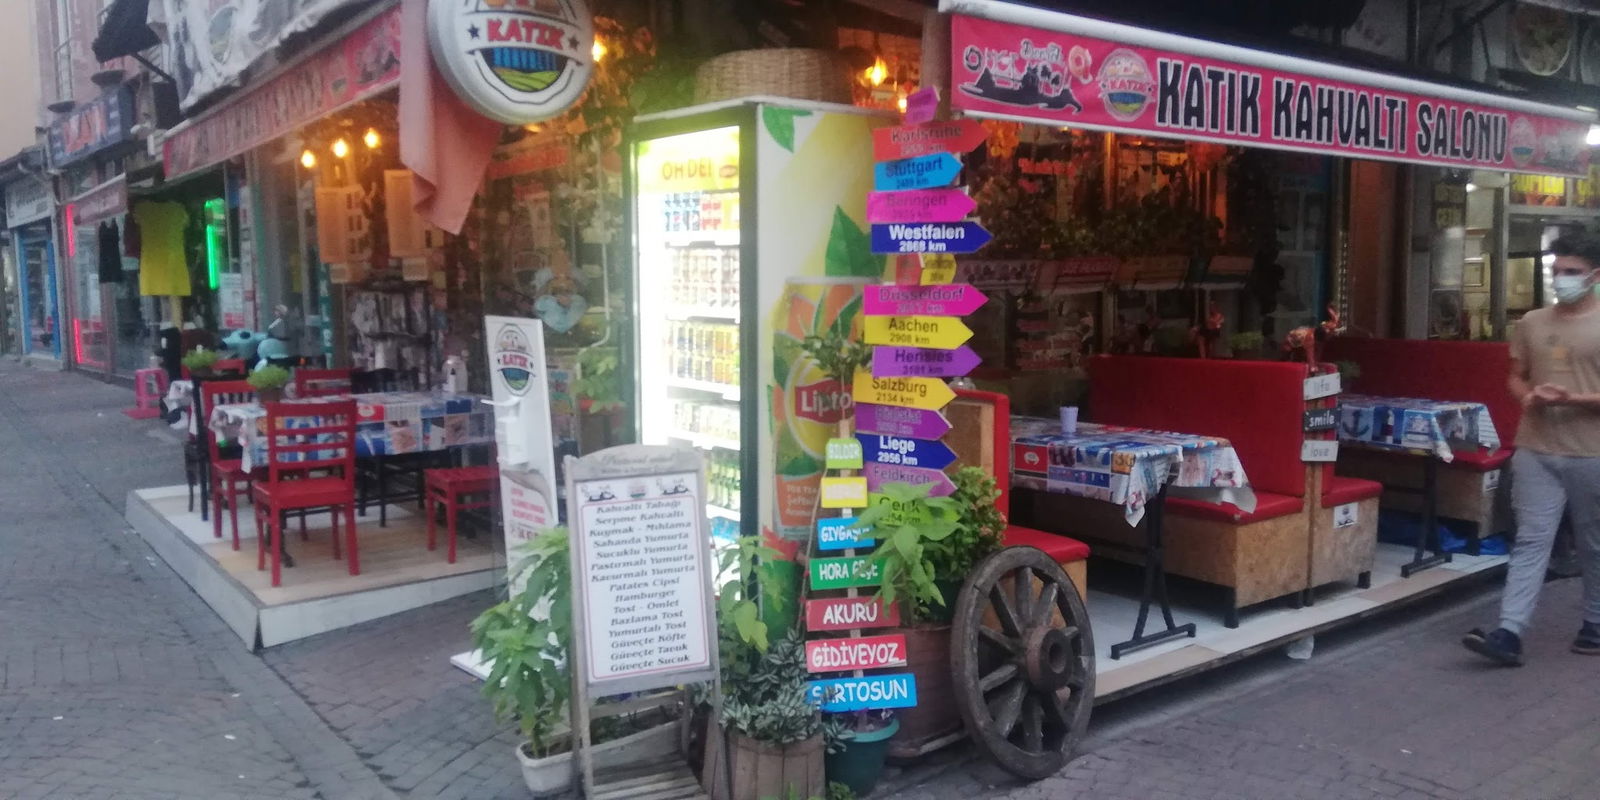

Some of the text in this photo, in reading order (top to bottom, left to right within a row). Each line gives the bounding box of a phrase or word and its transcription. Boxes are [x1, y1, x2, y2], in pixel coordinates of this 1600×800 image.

[487, 18, 566, 50] KATIK
[1156, 58, 1507, 163] KATIK KAHVALTI SALONU
[891, 126, 962, 143] Karlsruhe
[885, 156, 943, 178] Stuttgart
[889, 225, 965, 240] Westfalen
[928, 240, 946, 252] km
[888, 317, 938, 333] Aachen
[915, 335, 930, 345] km
[928, 365, 944, 374] km
[871, 377, 927, 397] Salzburg
[801, 389, 856, 416] Lipto
[900, 395, 915, 405] km
[1309, 410, 1335, 428] smile
[879, 435, 916, 454] Liege
[902, 455, 918, 466] km
[595, 515, 637, 525] Serpme
[589, 526, 634, 538] Kuymak
[593, 532, 689, 548] Sahanda Yumurta
[596, 543, 688, 559] Sucuklu Yumurta
[650, 553, 694, 564] Yumurta
[651, 564, 695, 576] Yumurta
[818, 562, 849, 580] HORA
[609, 581, 649, 592] Patates
[615, 589, 676, 603] Hamburger
[613, 605, 636, 614] Tost
[647, 599, 679, 610] Omlet
[822, 602, 878, 625] AKURU
[610, 610, 684, 626] Bazlama Tost
[609, 621, 687, 638] Yumurtalı Tost
[657, 633, 687, 643] Köfte
[658, 643, 688, 654] Tavuk
[811, 642, 904, 668] GİDİVEYOZ
[657, 654, 690, 665] Sucuk
[811, 679, 909, 705] SRTOSUN
